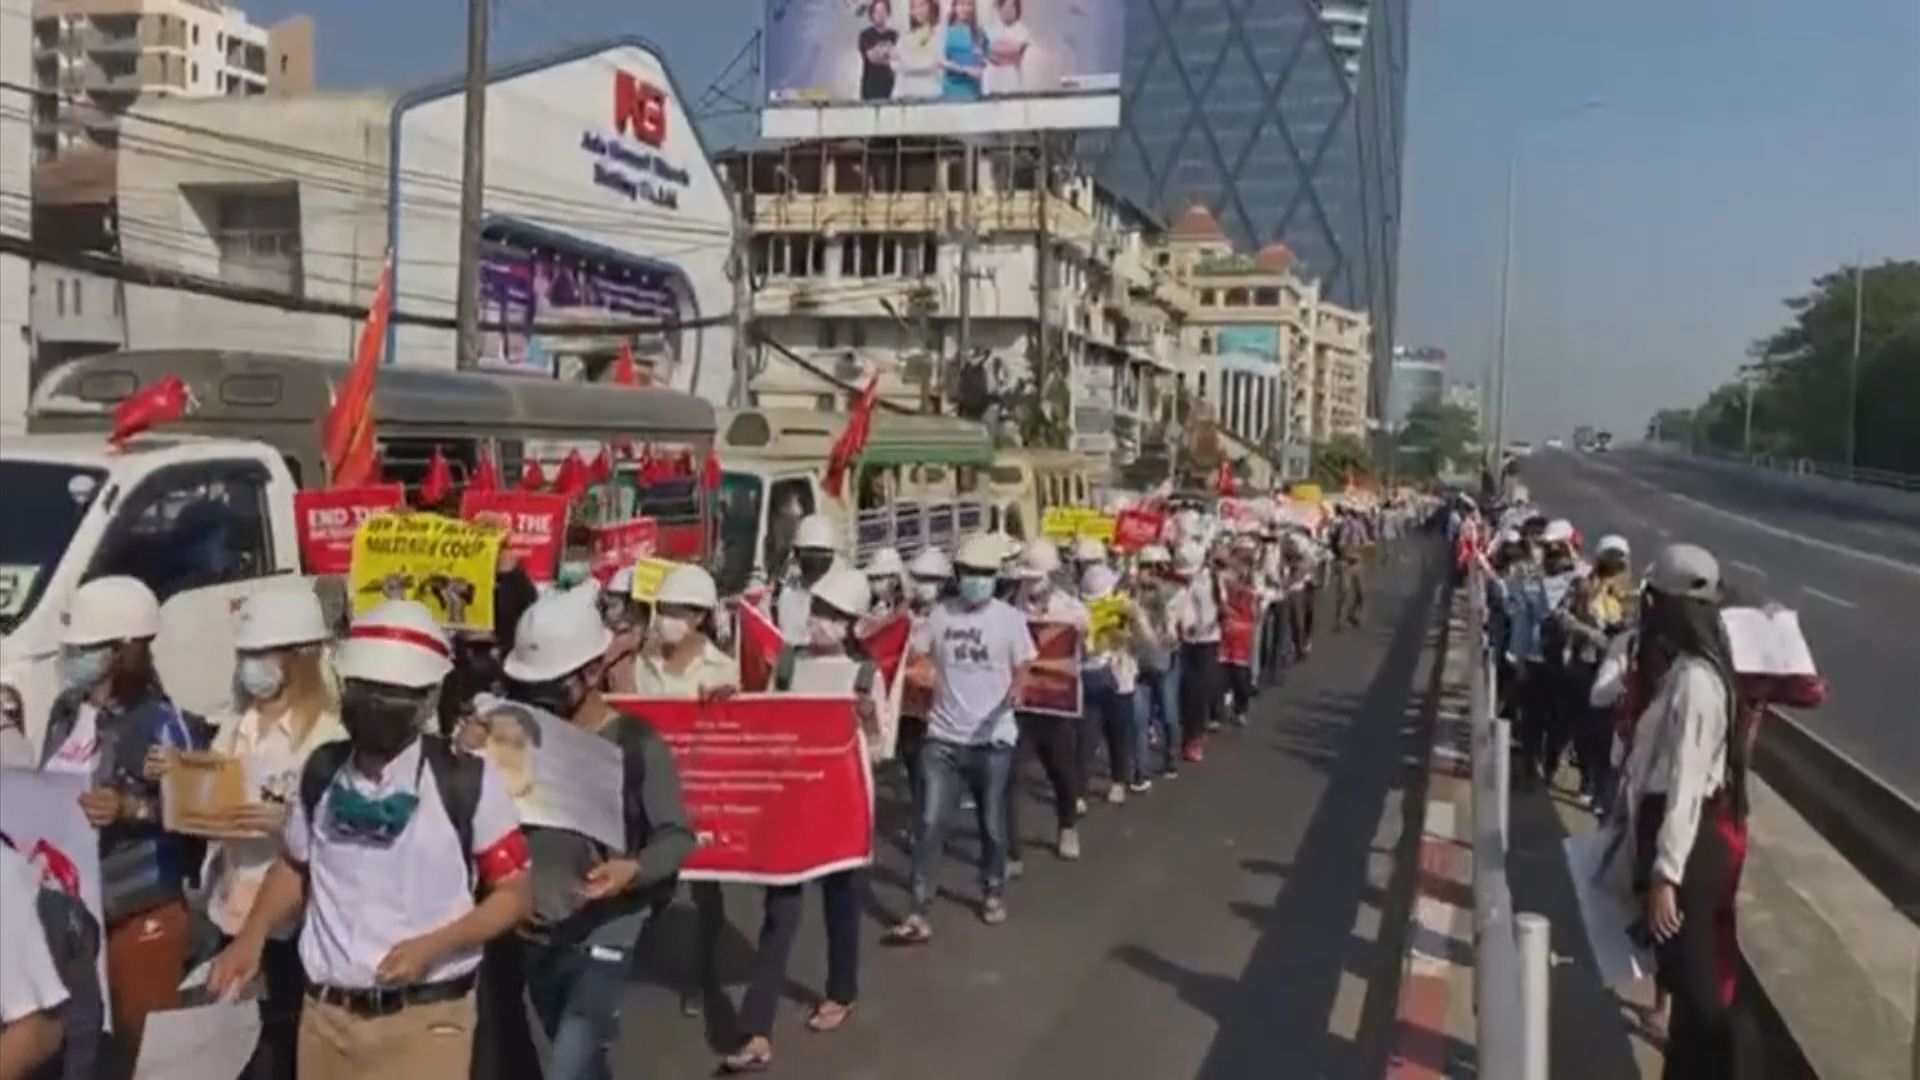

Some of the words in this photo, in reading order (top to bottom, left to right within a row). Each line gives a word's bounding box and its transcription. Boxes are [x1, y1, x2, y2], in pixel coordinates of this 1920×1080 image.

[307, 507, 350, 528] END
[516, 512, 554, 534] THE
[439, 538, 486, 559] COUP
